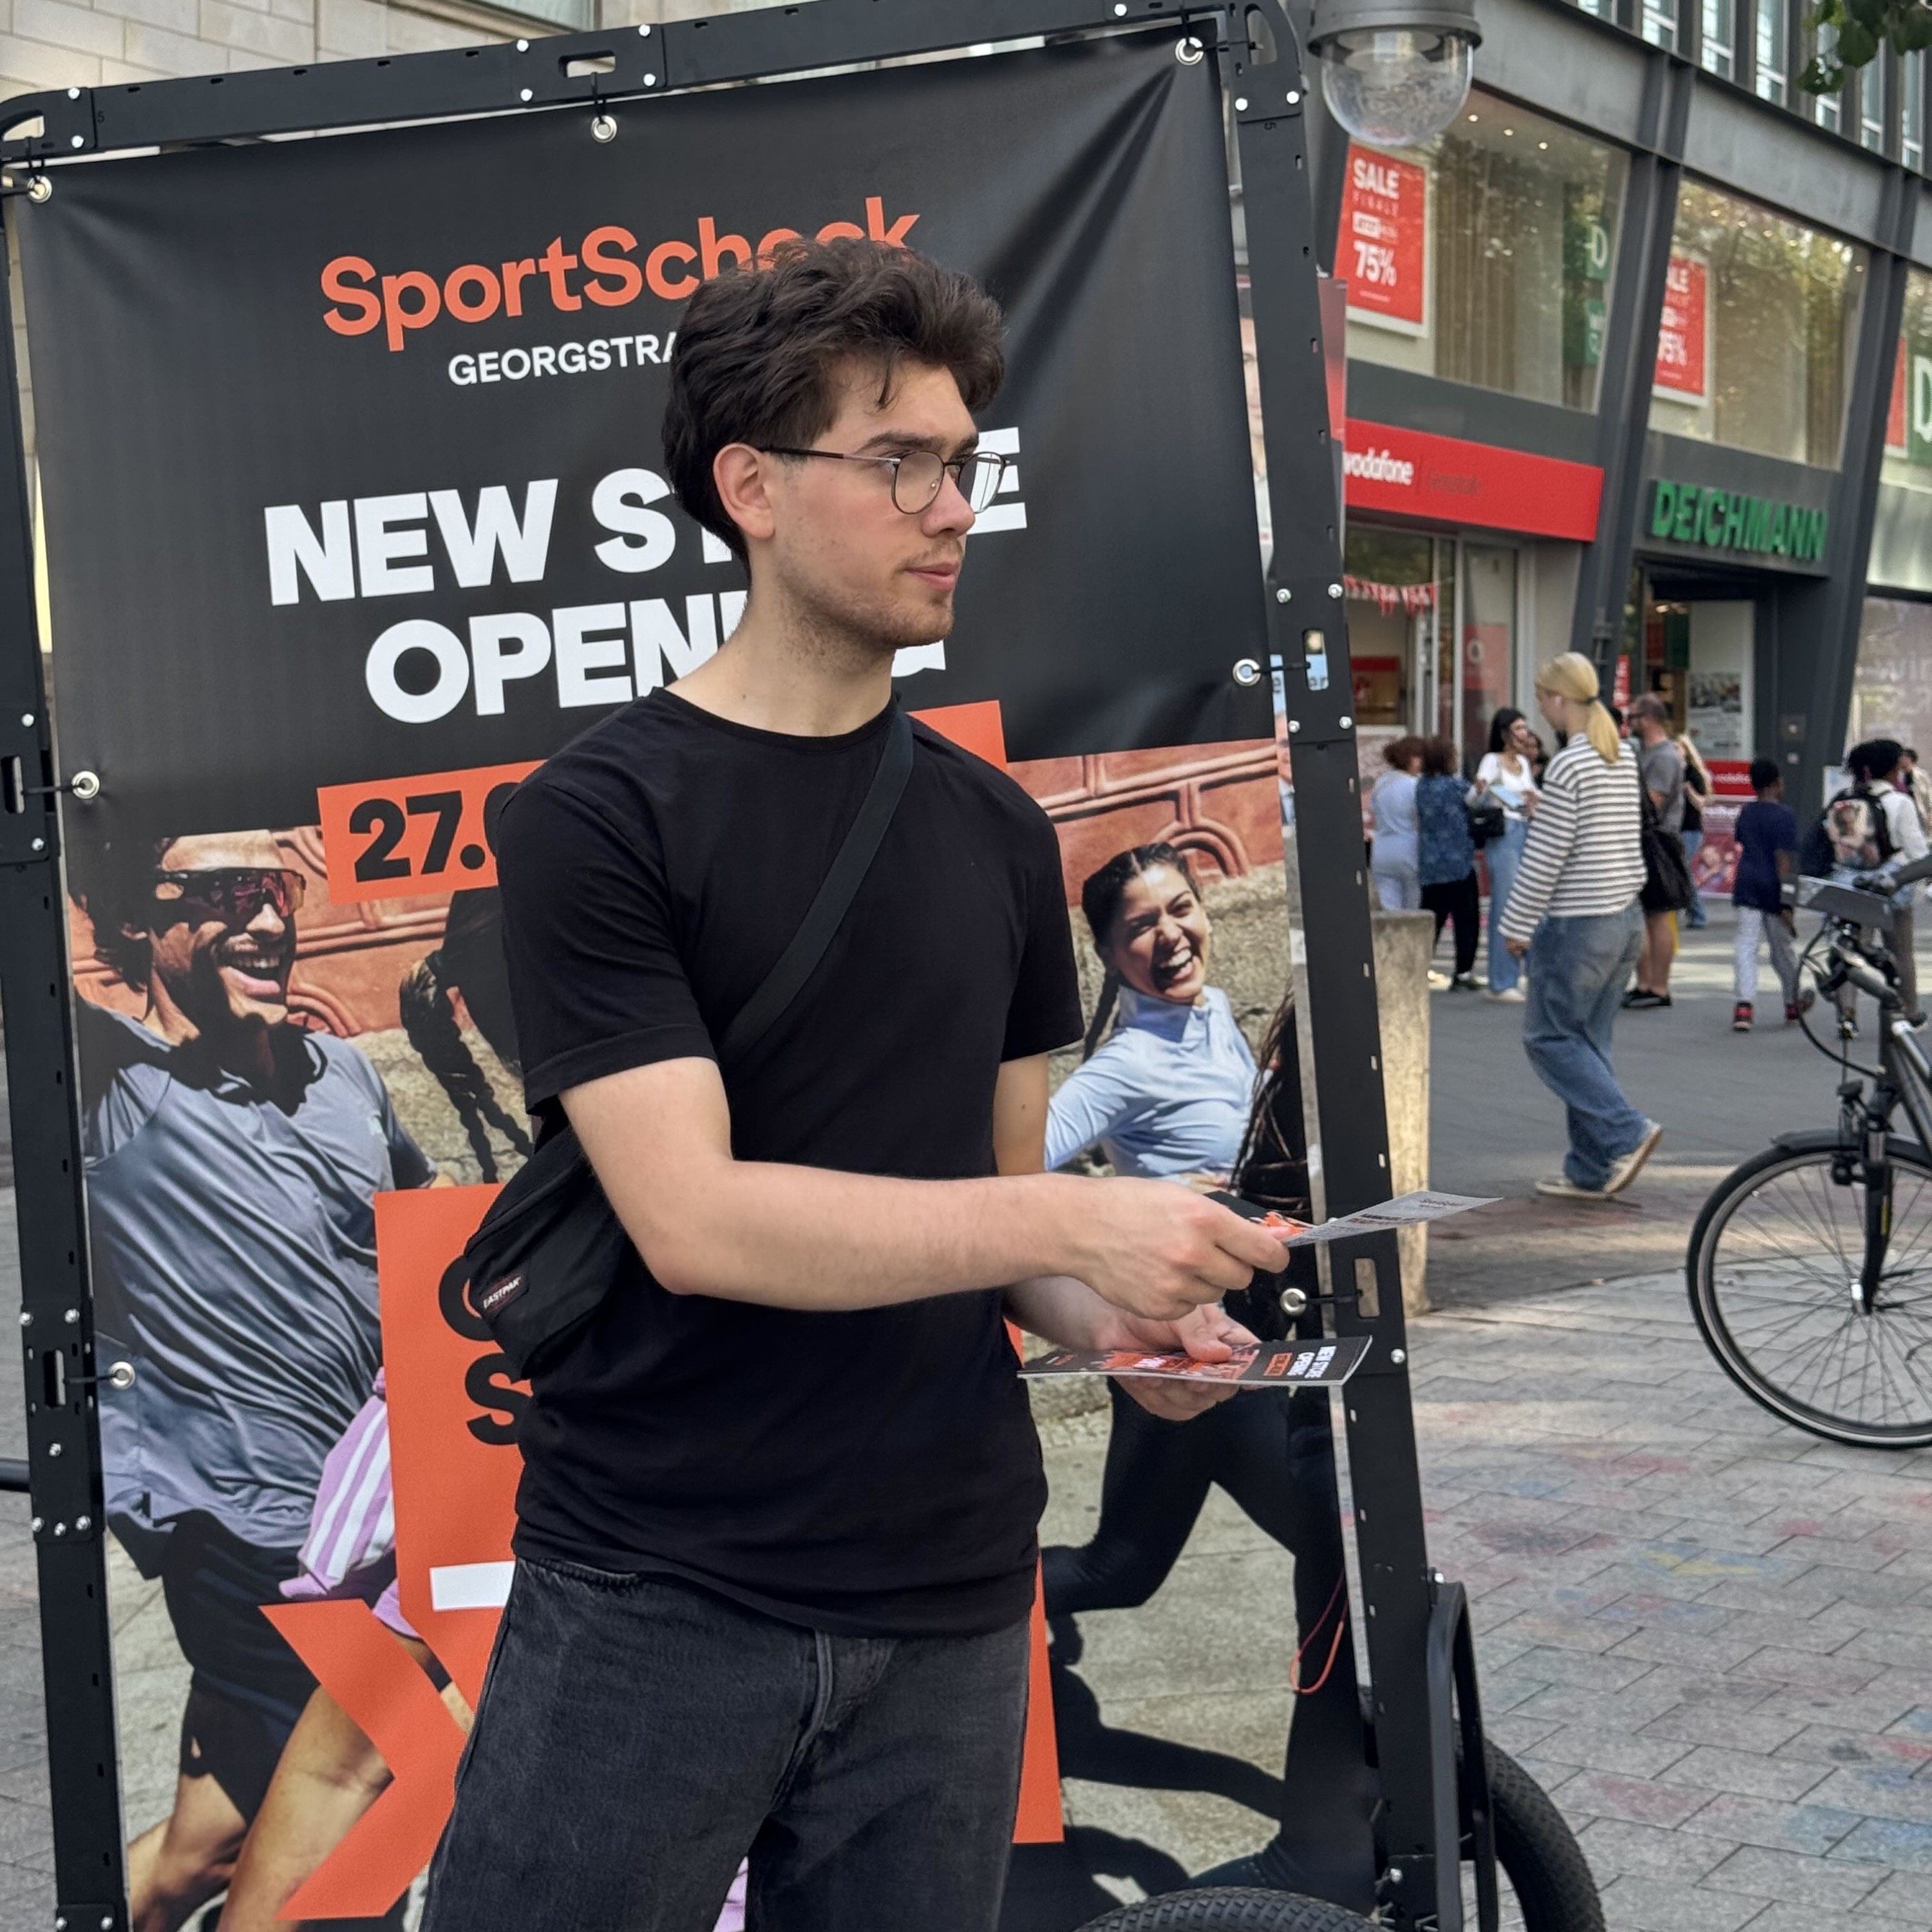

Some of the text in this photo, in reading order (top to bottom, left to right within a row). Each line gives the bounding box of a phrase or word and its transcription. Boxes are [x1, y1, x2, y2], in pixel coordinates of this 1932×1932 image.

[1354, 158, 1399, 200] SALE
[1353, 240, 1397, 287] 75%
[265, 478, 558, 606] NEW
[1652, 479, 1828, 563] DEICHMANN
[366, 590, 947, 724] OPEN
[483, 1276, 522, 1310] EASTPAK
